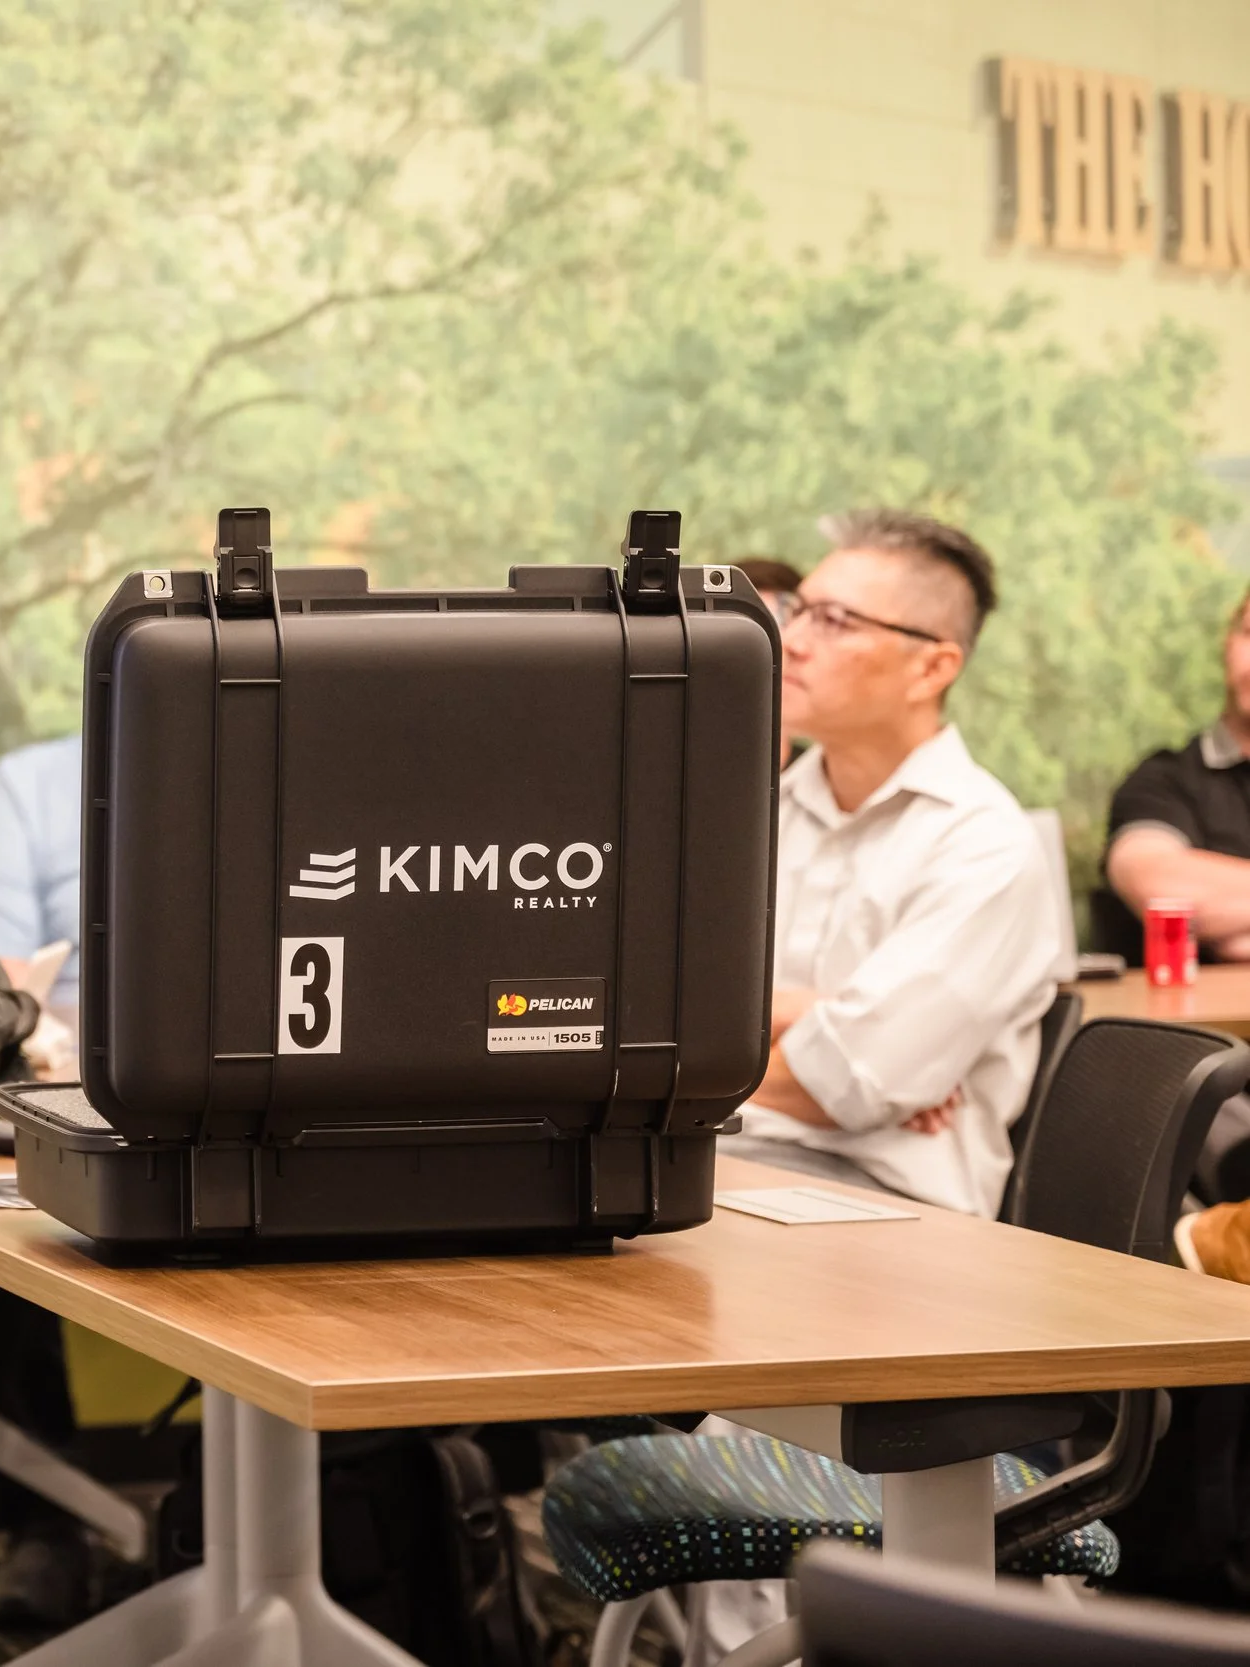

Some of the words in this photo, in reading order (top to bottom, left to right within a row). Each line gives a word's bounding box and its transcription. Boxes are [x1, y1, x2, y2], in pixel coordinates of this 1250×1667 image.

[998, 54, 1154, 258] THE
[513, 896, 597, 909] REALTY
[288, 943, 332, 1049] 3
[528, 997, 594, 1011] PELICAN
[553, 1033, 591, 1043] 1505
